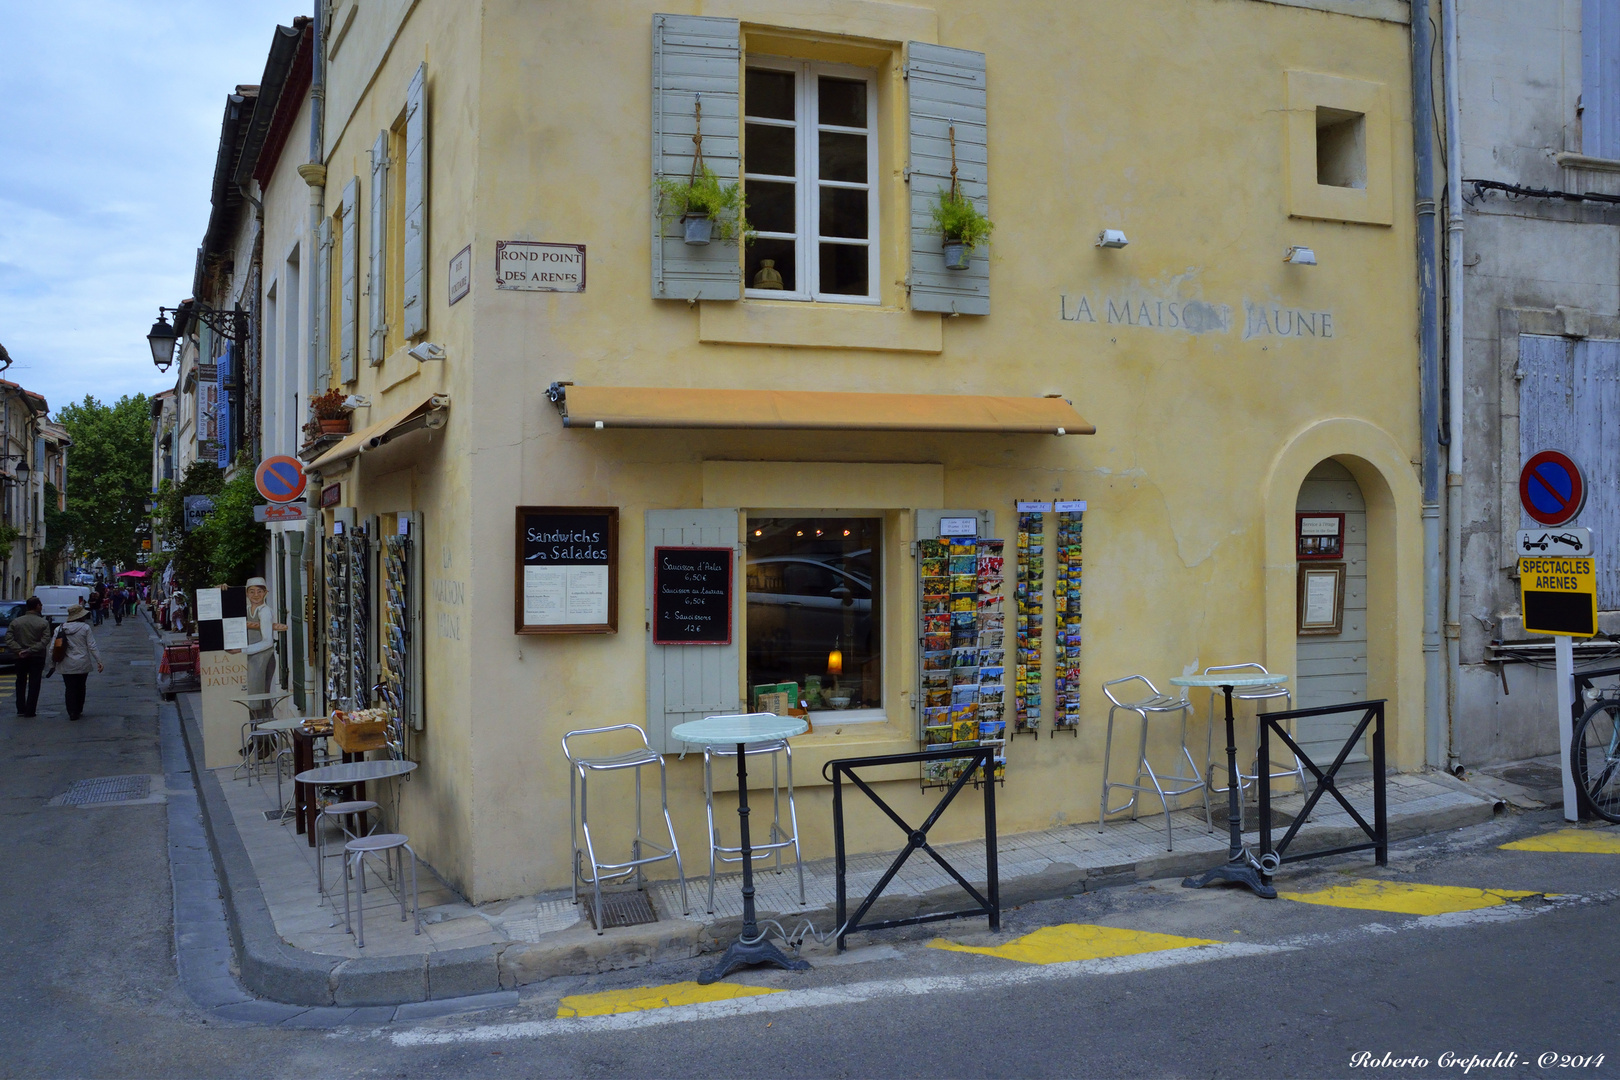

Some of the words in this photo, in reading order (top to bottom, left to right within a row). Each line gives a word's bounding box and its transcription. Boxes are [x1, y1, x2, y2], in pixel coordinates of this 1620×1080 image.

[501, 251, 538, 261] ROND
[542, 252, 582, 263] POINT
[504, 271, 526, 280] DES
[531, 272, 577, 282] ARENES
[1059, 294, 1096, 323] LA
[1245, 304, 1333, 340] JAUNE
[526, 528, 600, 542] Sandwichs
[442, 545, 452, 568] LA
[550, 545, 608, 560] Salades
[662, 556, 694, 571] Saucisson
[697, 561, 722, 571] d'Arles
[1522, 560, 1590, 574] SPECTACLES
[662, 584, 690, 594] Saucisson
[1536, 576, 1578, 590] ARENES
[664, 611, 670, 620] 2
[674, 610, 712, 620] Saucissons
[214, 654, 230, 664] LA
[202, 664, 249, 676] MAISON
[207, 676, 247, 687] JAUNE
